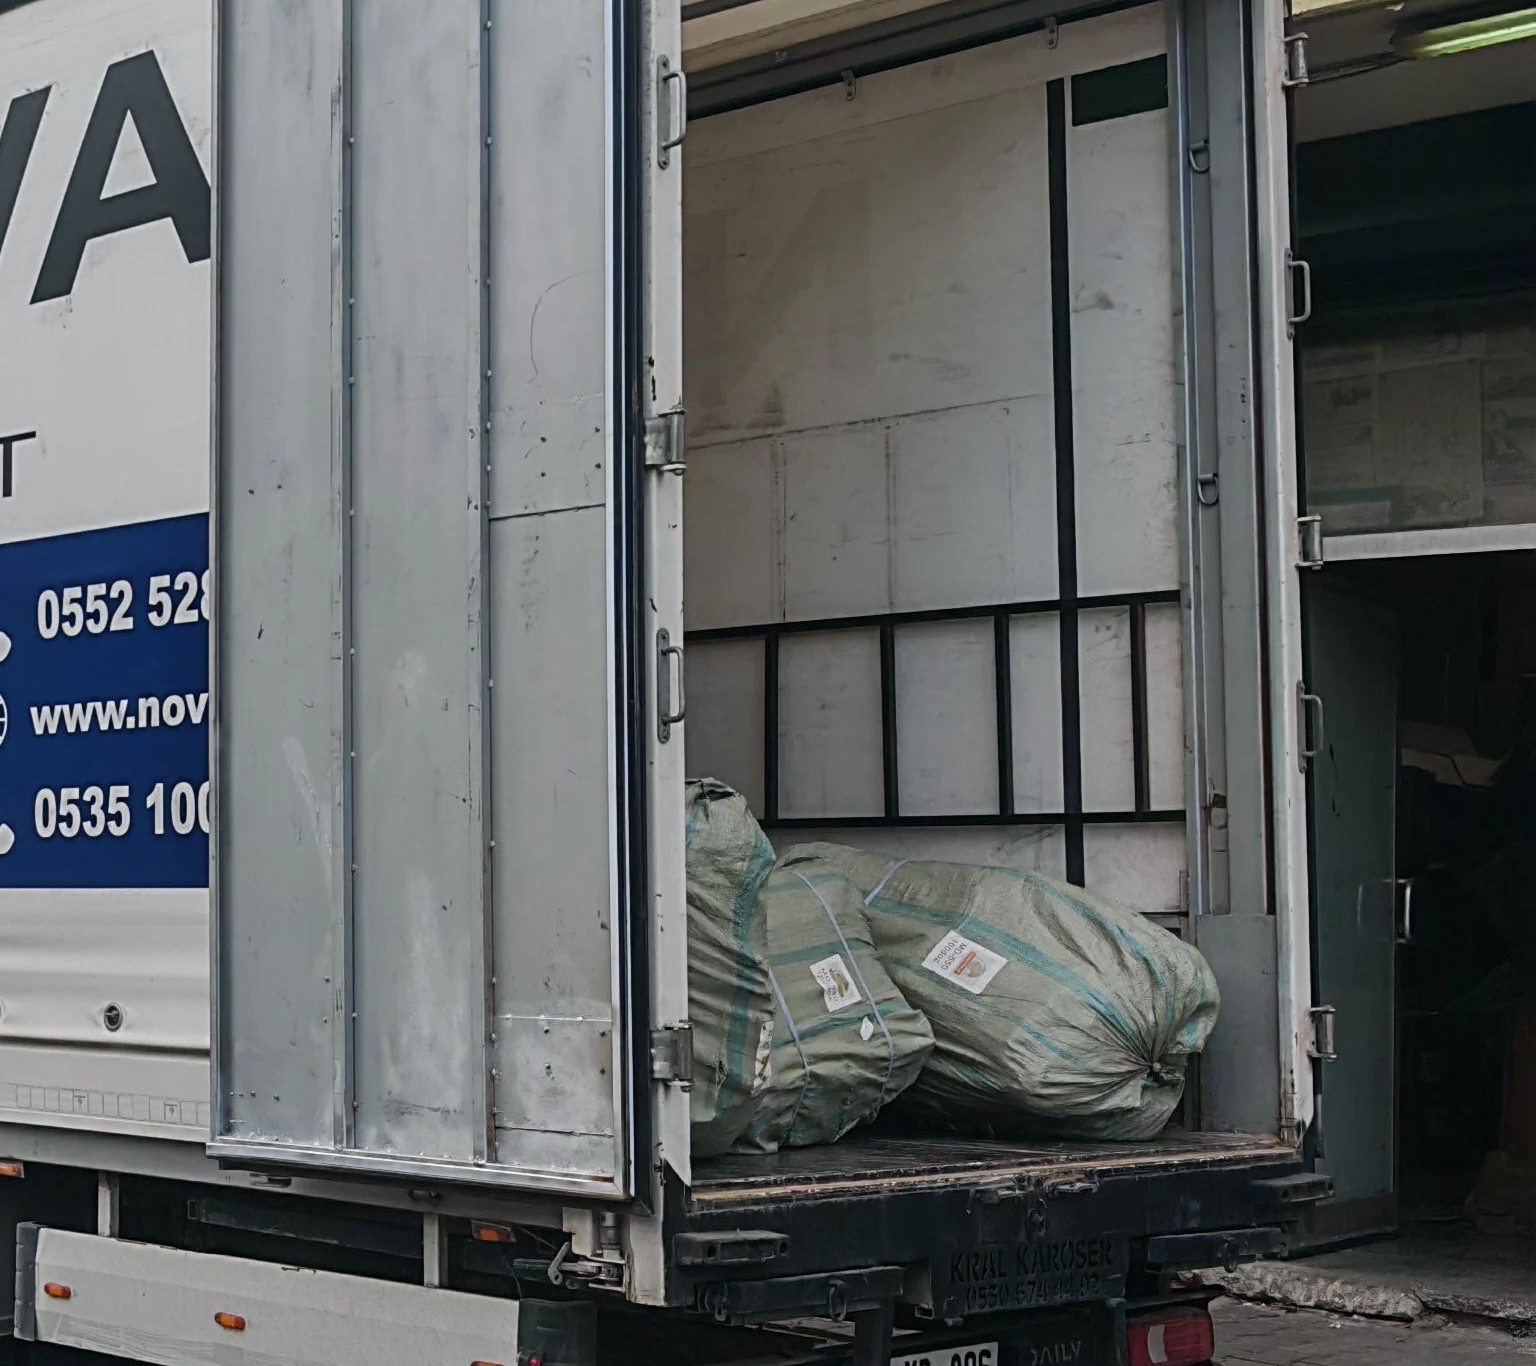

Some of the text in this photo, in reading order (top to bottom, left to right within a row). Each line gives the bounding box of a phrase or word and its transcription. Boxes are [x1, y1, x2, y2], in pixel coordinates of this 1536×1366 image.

[37, 579, 134, 639] 0552
[34, 785, 131, 838] 0535
[950, 1237, 1113, 1284] KRAL KAROSER
